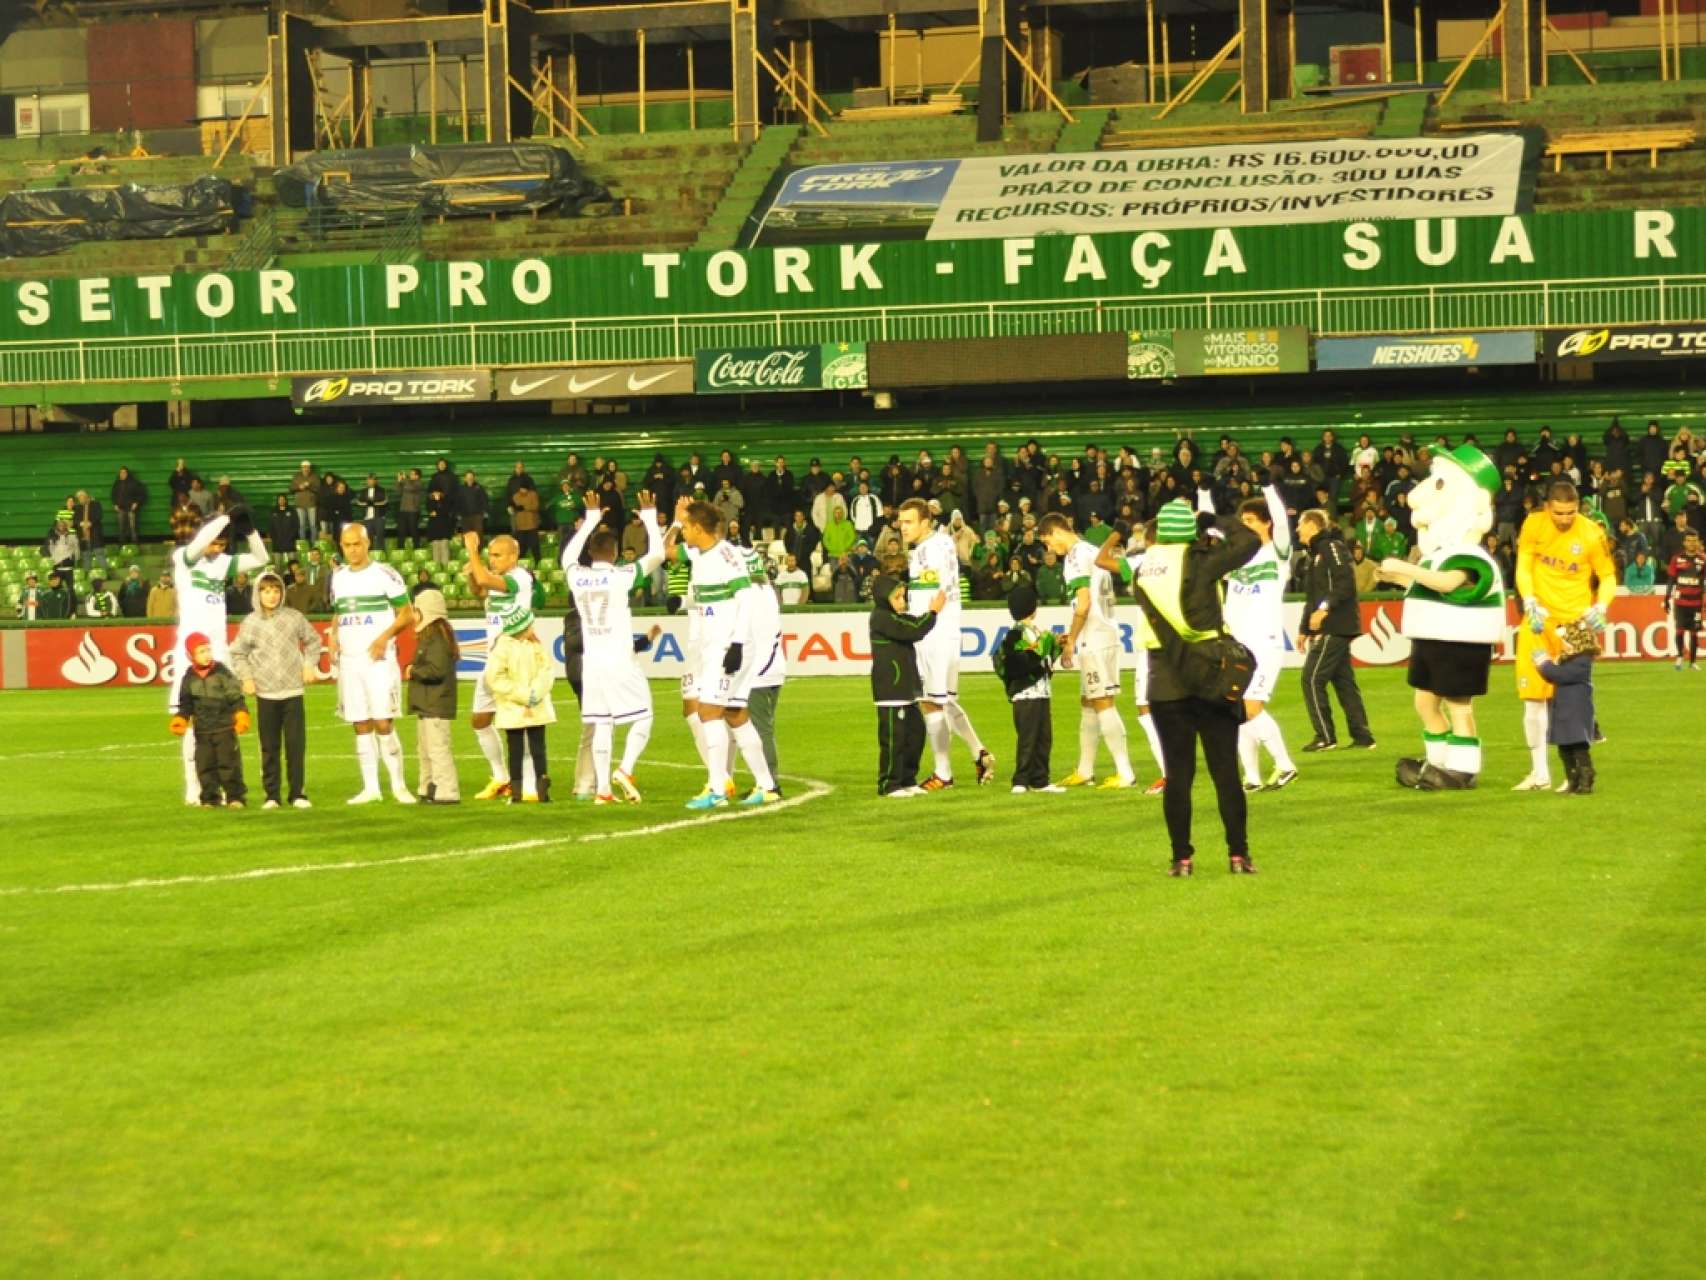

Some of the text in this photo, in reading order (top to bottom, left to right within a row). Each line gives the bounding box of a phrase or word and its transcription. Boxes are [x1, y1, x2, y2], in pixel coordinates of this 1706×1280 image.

[1000, 159, 1084, 178] VALOR
[1092, 159, 1128, 173] DA
[1136, 156, 1219, 172] OBRA:
[1000, 180, 1092, 198] PRAZO
[1099, 179, 1137, 194] DE
[1142, 170, 1323, 193] CONCLUSÃO:
[1331, 167, 1387, 183] 300
[955, 201, 1114, 223] RECURSOS:
[17, 270, 297, 326] SETOR
[386, 259, 552, 310] PRO
[642, 243, 884, 299] TORK
[1003, 229, 1248, 289] FAÇA
[1343, 216, 1535, 271] SUA
[1634, 210, 1678, 258] R
[1210, 331, 1247, 344] MAIS
[1608, 332, 1674, 351] PRO
[1204, 342, 1279, 356] VITORIOSO
[1372, 344, 1463, 366] NETSHOES
[1217, 354, 1279, 368] MUNDO
[348, 378, 477, 396] PRO TORK
